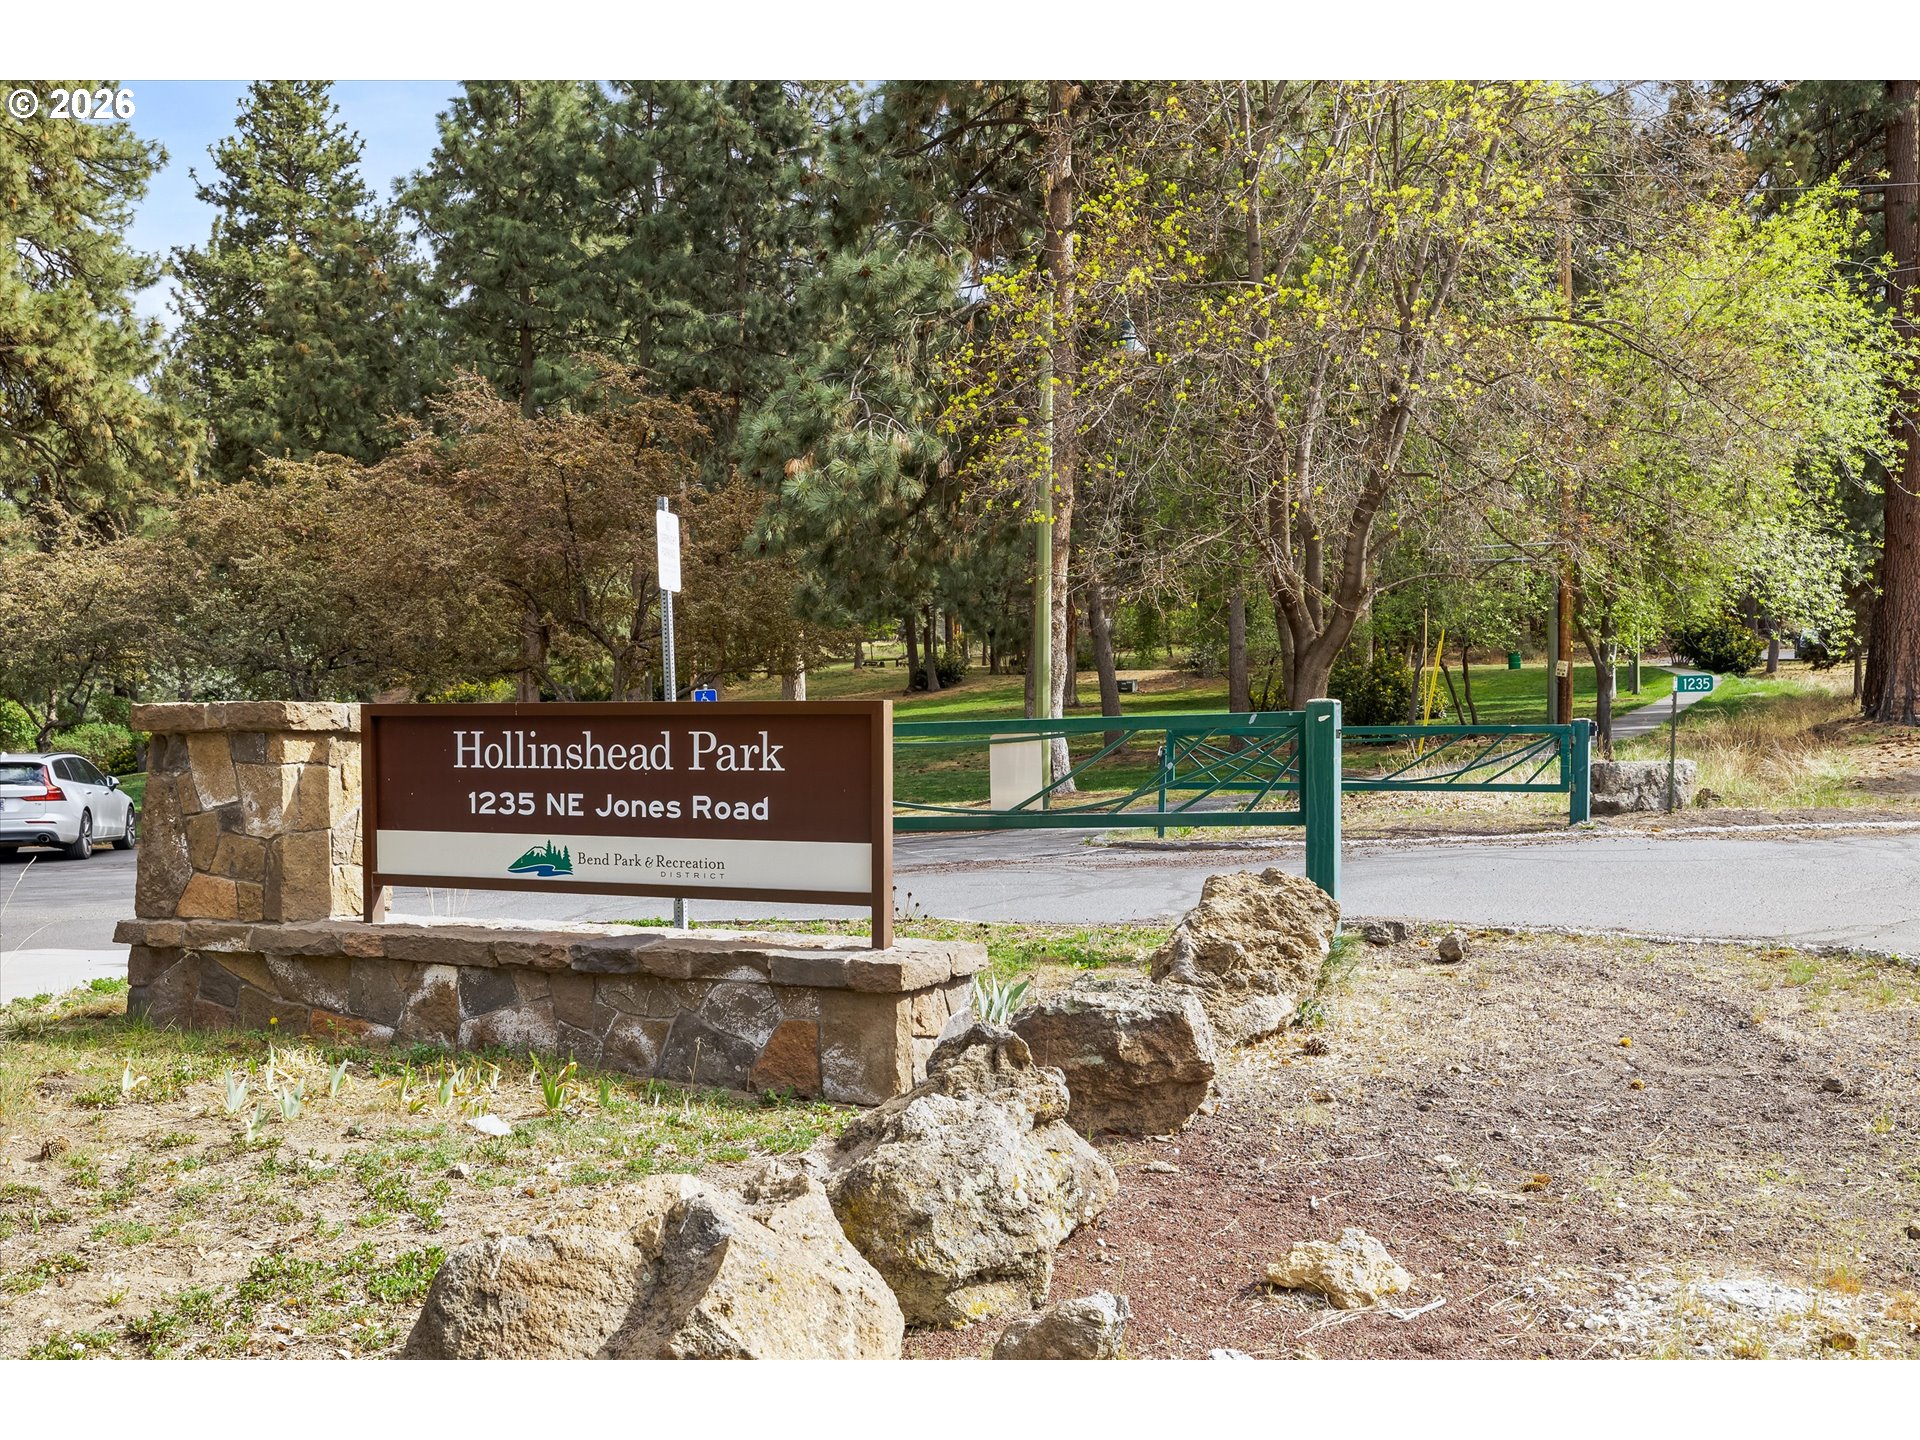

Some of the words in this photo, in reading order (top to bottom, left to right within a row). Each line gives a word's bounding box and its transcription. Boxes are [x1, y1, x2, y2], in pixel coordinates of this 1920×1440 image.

[1683, 677, 1711, 690] 1235
[453, 730, 674, 771] Hollinshead
[687, 731, 786, 772] Park
[468, 791, 536, 816] 1235
[546, 792, 585, 817] NE
[595, 793, 682, 819] Jones
[692, 795, 769, 821] Road
[577, 851, 610, 866] Bend
[613, 853, 642, 867] Park
[644, 856, 654, 868] &
[655, 854, 726, 870] Recreation
[660, 870, 726, 880] DISTRICT
